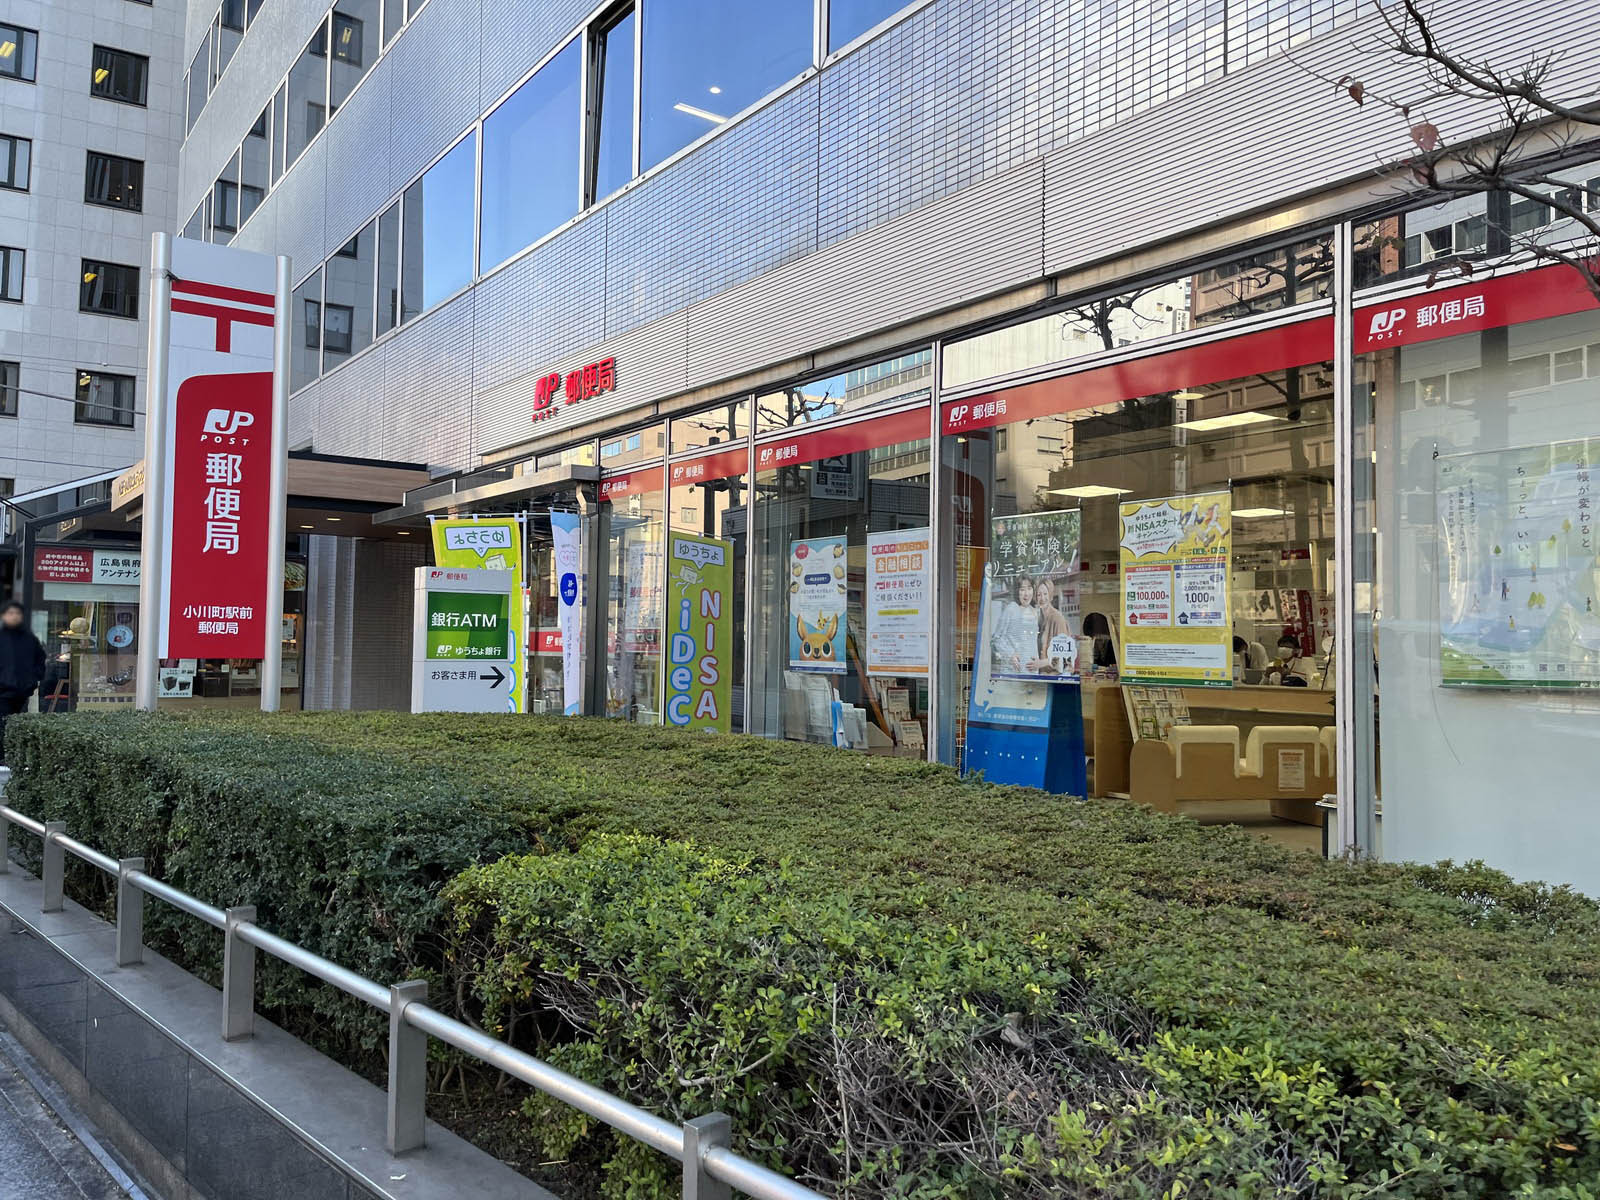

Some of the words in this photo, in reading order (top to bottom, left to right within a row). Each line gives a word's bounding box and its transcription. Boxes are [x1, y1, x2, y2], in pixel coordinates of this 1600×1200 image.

[1370, 309, 1406, 334] JP
[1416, 295, 1485, 328] 郵便局
[1368, 330, 1403, 342] POST
[533, 372, 559, 411] JP
[565, 356, 615, 405] 郵便局
[532, 407, 558, 422] POST
[949, 405, 968, 422] JP
[973, 399, 1006, 420] 郵便局
[203, 408, 255, 435] JP
[200, 434, 249, 446] POST
[760, 448, 773, 462] JP
[776, 445, 798, 460] 郵便局
[685, 464, 704, 478] 郵便局
[202, 453, 243, 555] 郵便局
[679, 543, 719, 561] ゆうちょ
[1000, 537, 1070, 558] 学資保険を
[100, 558, 141, 568] 広島県府
[993, 549, 1077, 577] リニューアル!
[100, 569, 141, 578] アンテナシ
[446, 573, 468, 581] 郵便局
[1185, 592, 1215, 603] 1,000円
[183, 605, 253, 619] 小川町駅前
[431, 612, 497, 628] 銀行ATM
[198, 621, 239, 635] 郵便局
[437, 645, 453, 654] JP
[455, 646, 502, 656] ゆうちょ銀行
[1052, 641, 1073, 652] No.1
[695, 588, 721, 720] NISA
[431, 670, 477, 681] お客さま用
